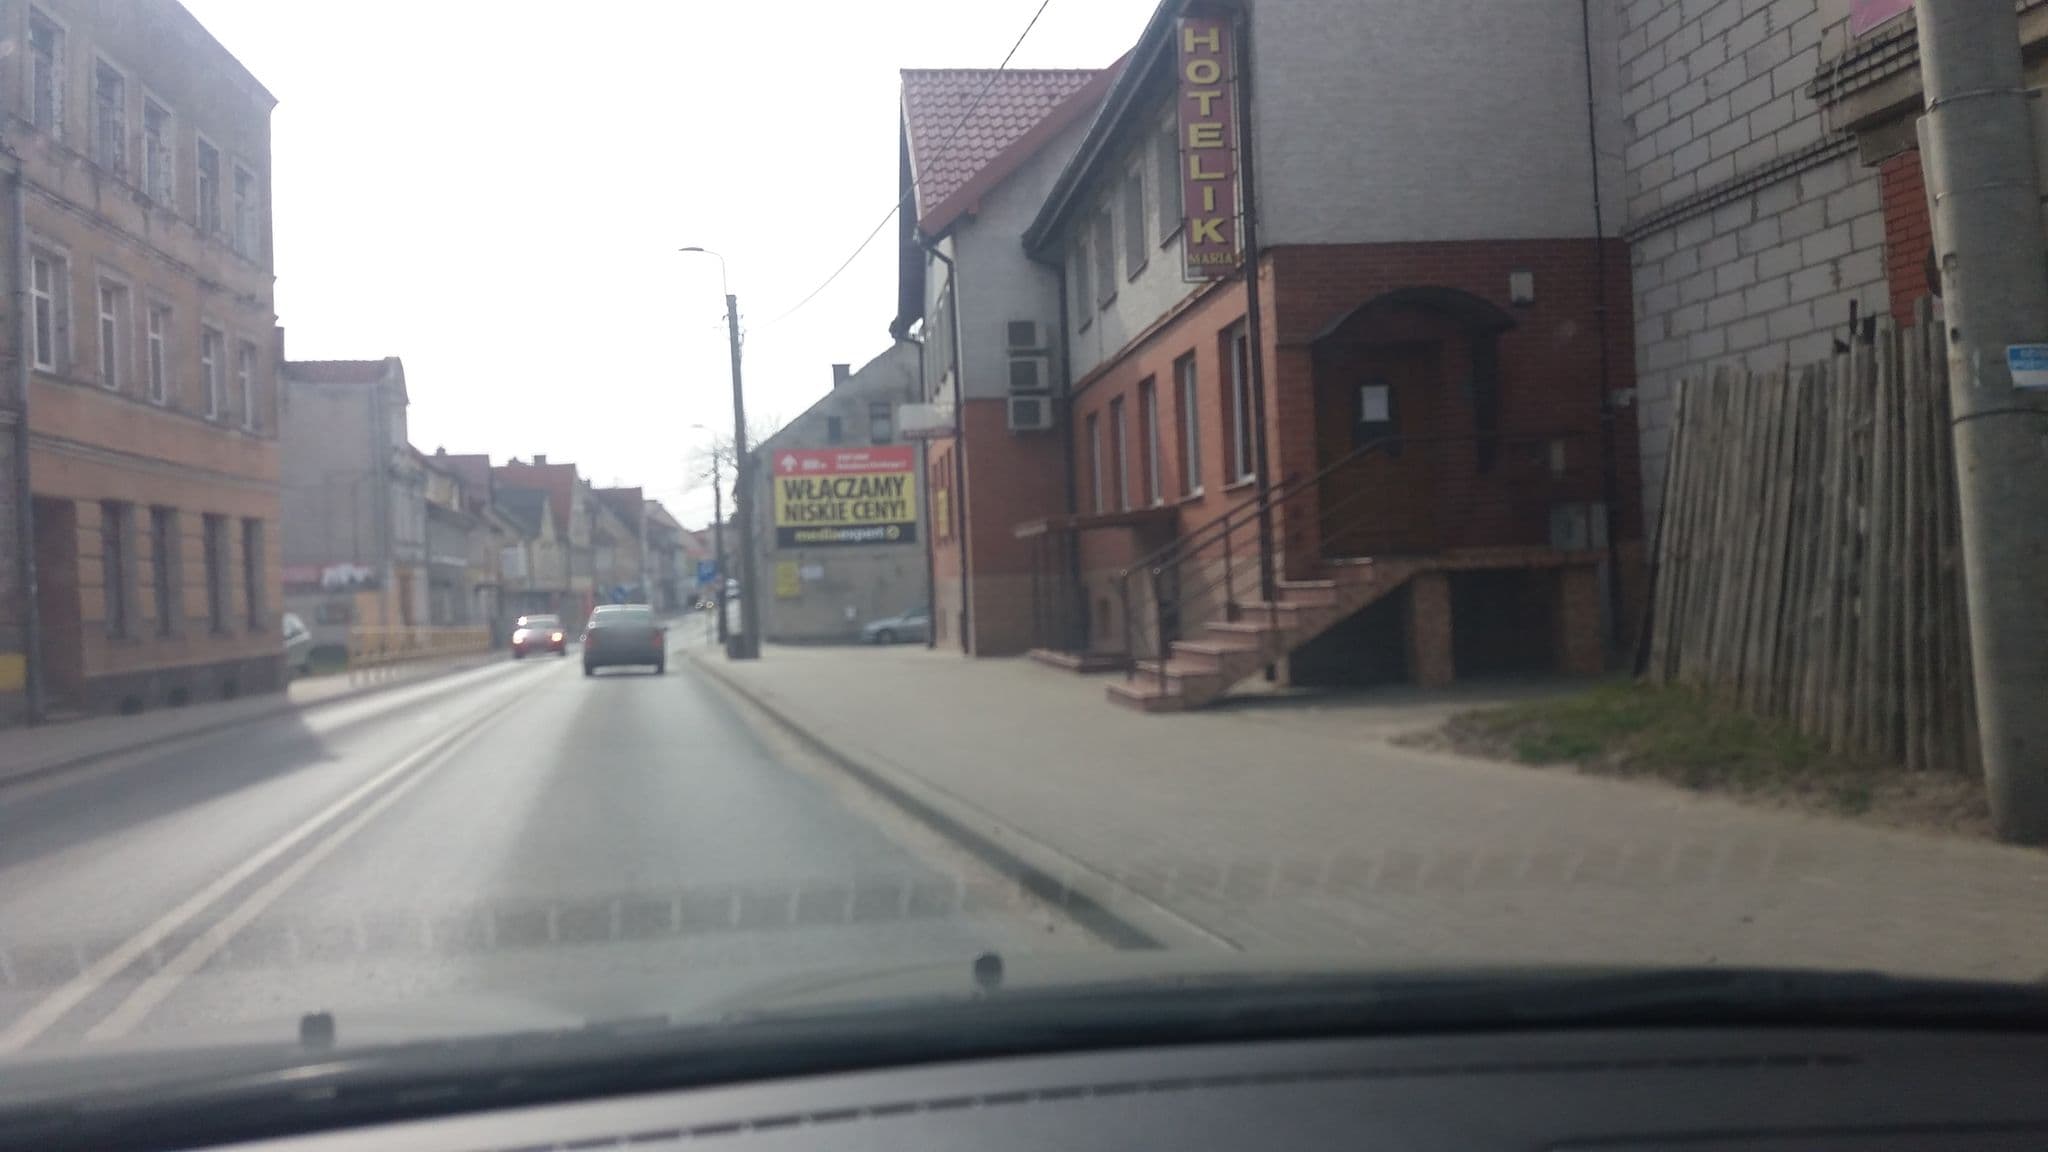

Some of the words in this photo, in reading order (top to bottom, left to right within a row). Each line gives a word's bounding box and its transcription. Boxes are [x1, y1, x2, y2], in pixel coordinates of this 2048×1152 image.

[1184, 27, 1226, 244] HOTELIK
[1188, 253, 1233, 265] MARIA
[785, 502, 847, 521] NISKIE
[853, 500, 906, 520] CENY!
